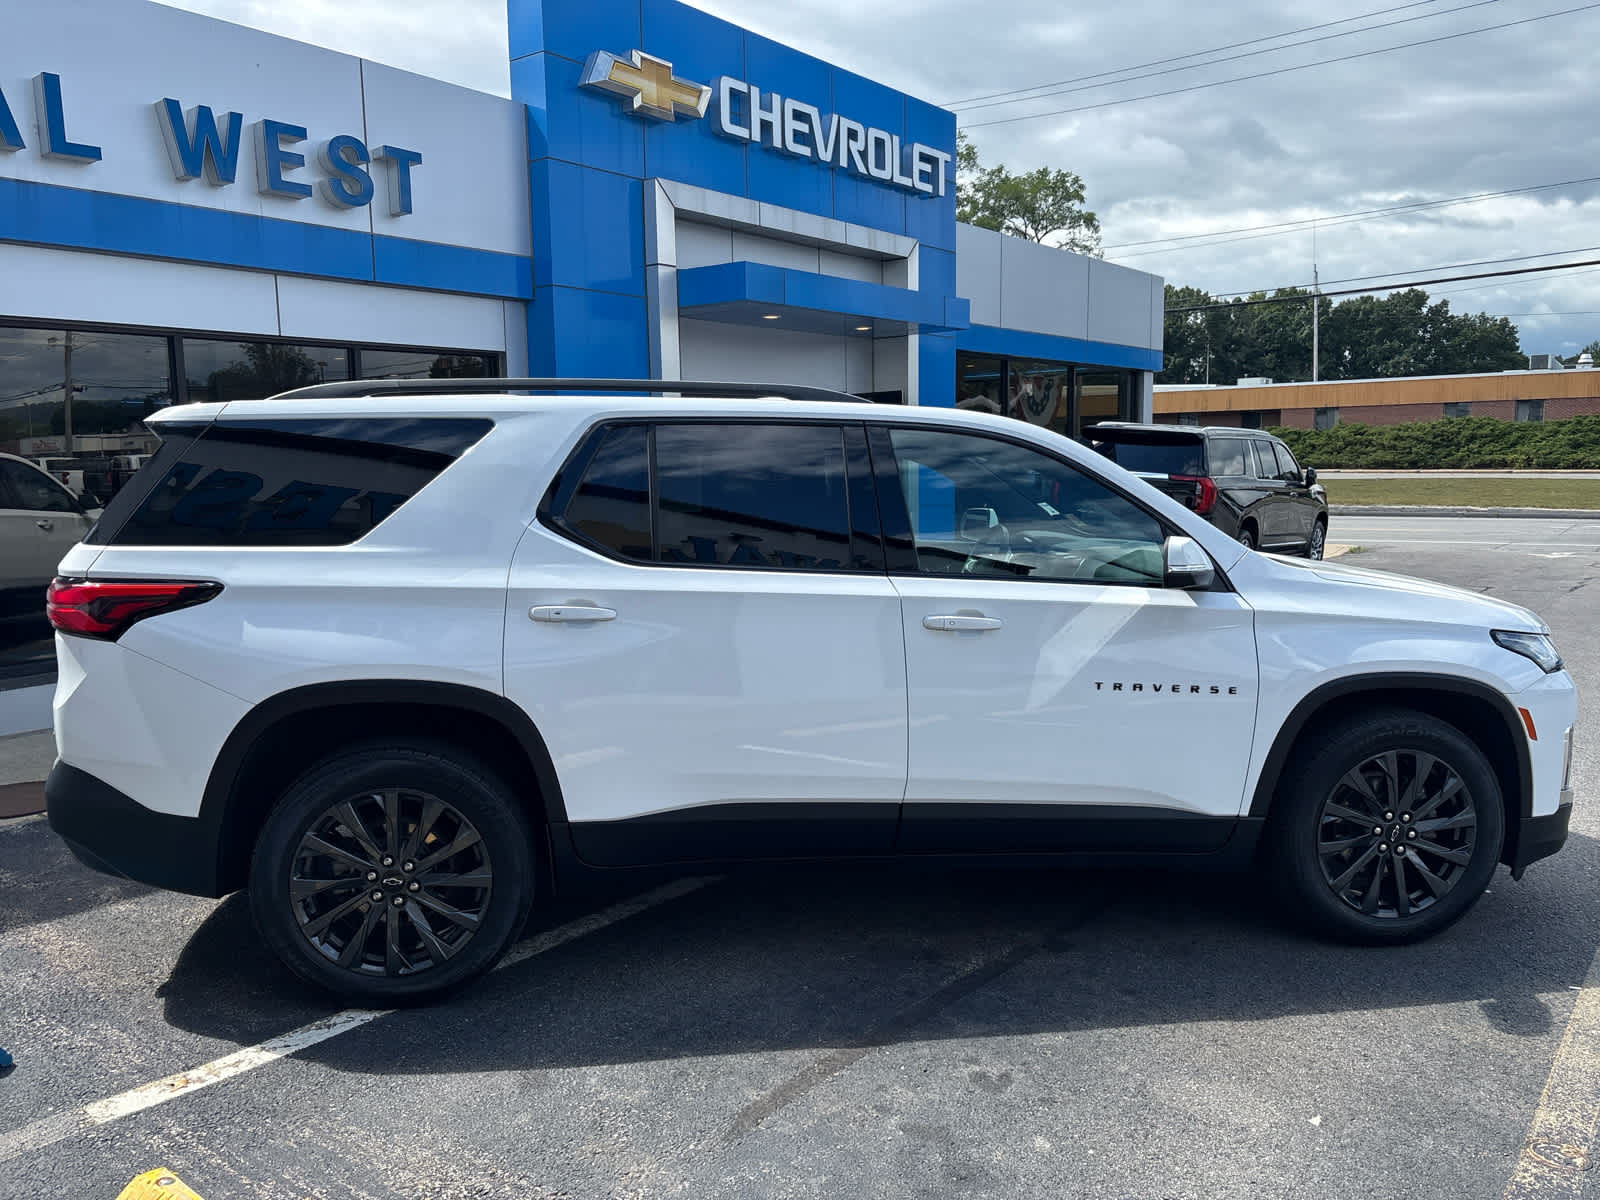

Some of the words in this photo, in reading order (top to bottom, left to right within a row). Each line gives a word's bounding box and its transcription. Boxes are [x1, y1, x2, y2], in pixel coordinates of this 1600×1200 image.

[155, 97, 422, 217] WEST
[713, 75, 952, 197] CHEVROLET
[1094, 681, 1238, 695] TRAVERSE
